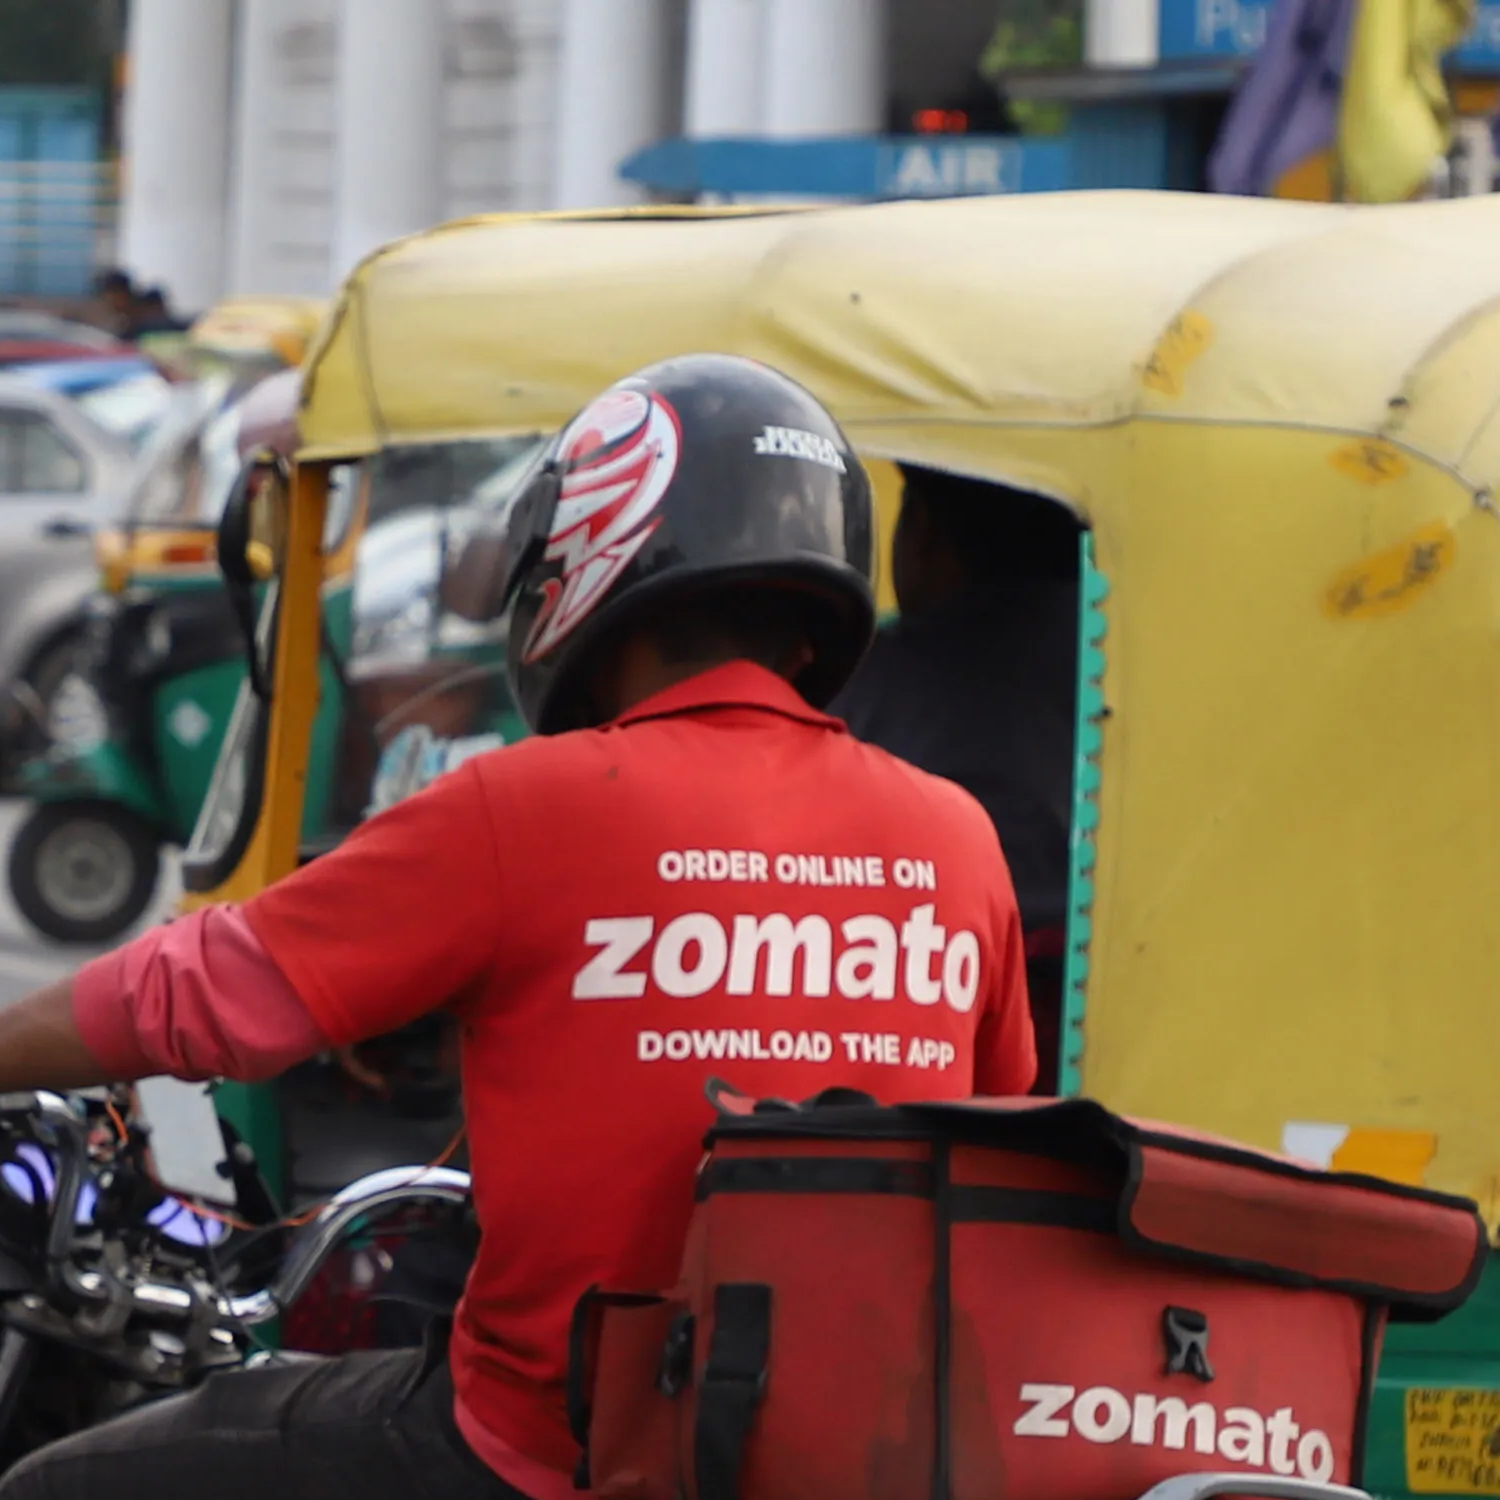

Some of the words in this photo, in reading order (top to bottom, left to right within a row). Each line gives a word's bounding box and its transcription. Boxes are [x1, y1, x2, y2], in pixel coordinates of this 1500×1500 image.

[889, 146, 1005, 194] AIR
[657, 849, 768, 883] ORDER
[774, 854, 886, 887] ONLINE
[893, 858, 937, 891] ON
[571, 903, 981, 1013] zomato
[637, 1029, 832, 1062] DOWNLOAD
[841, 1032, 901, 1064] THE
[907, 1036, 955, 1070] APP
[1013, 1383, 1335, 1485] zomato
